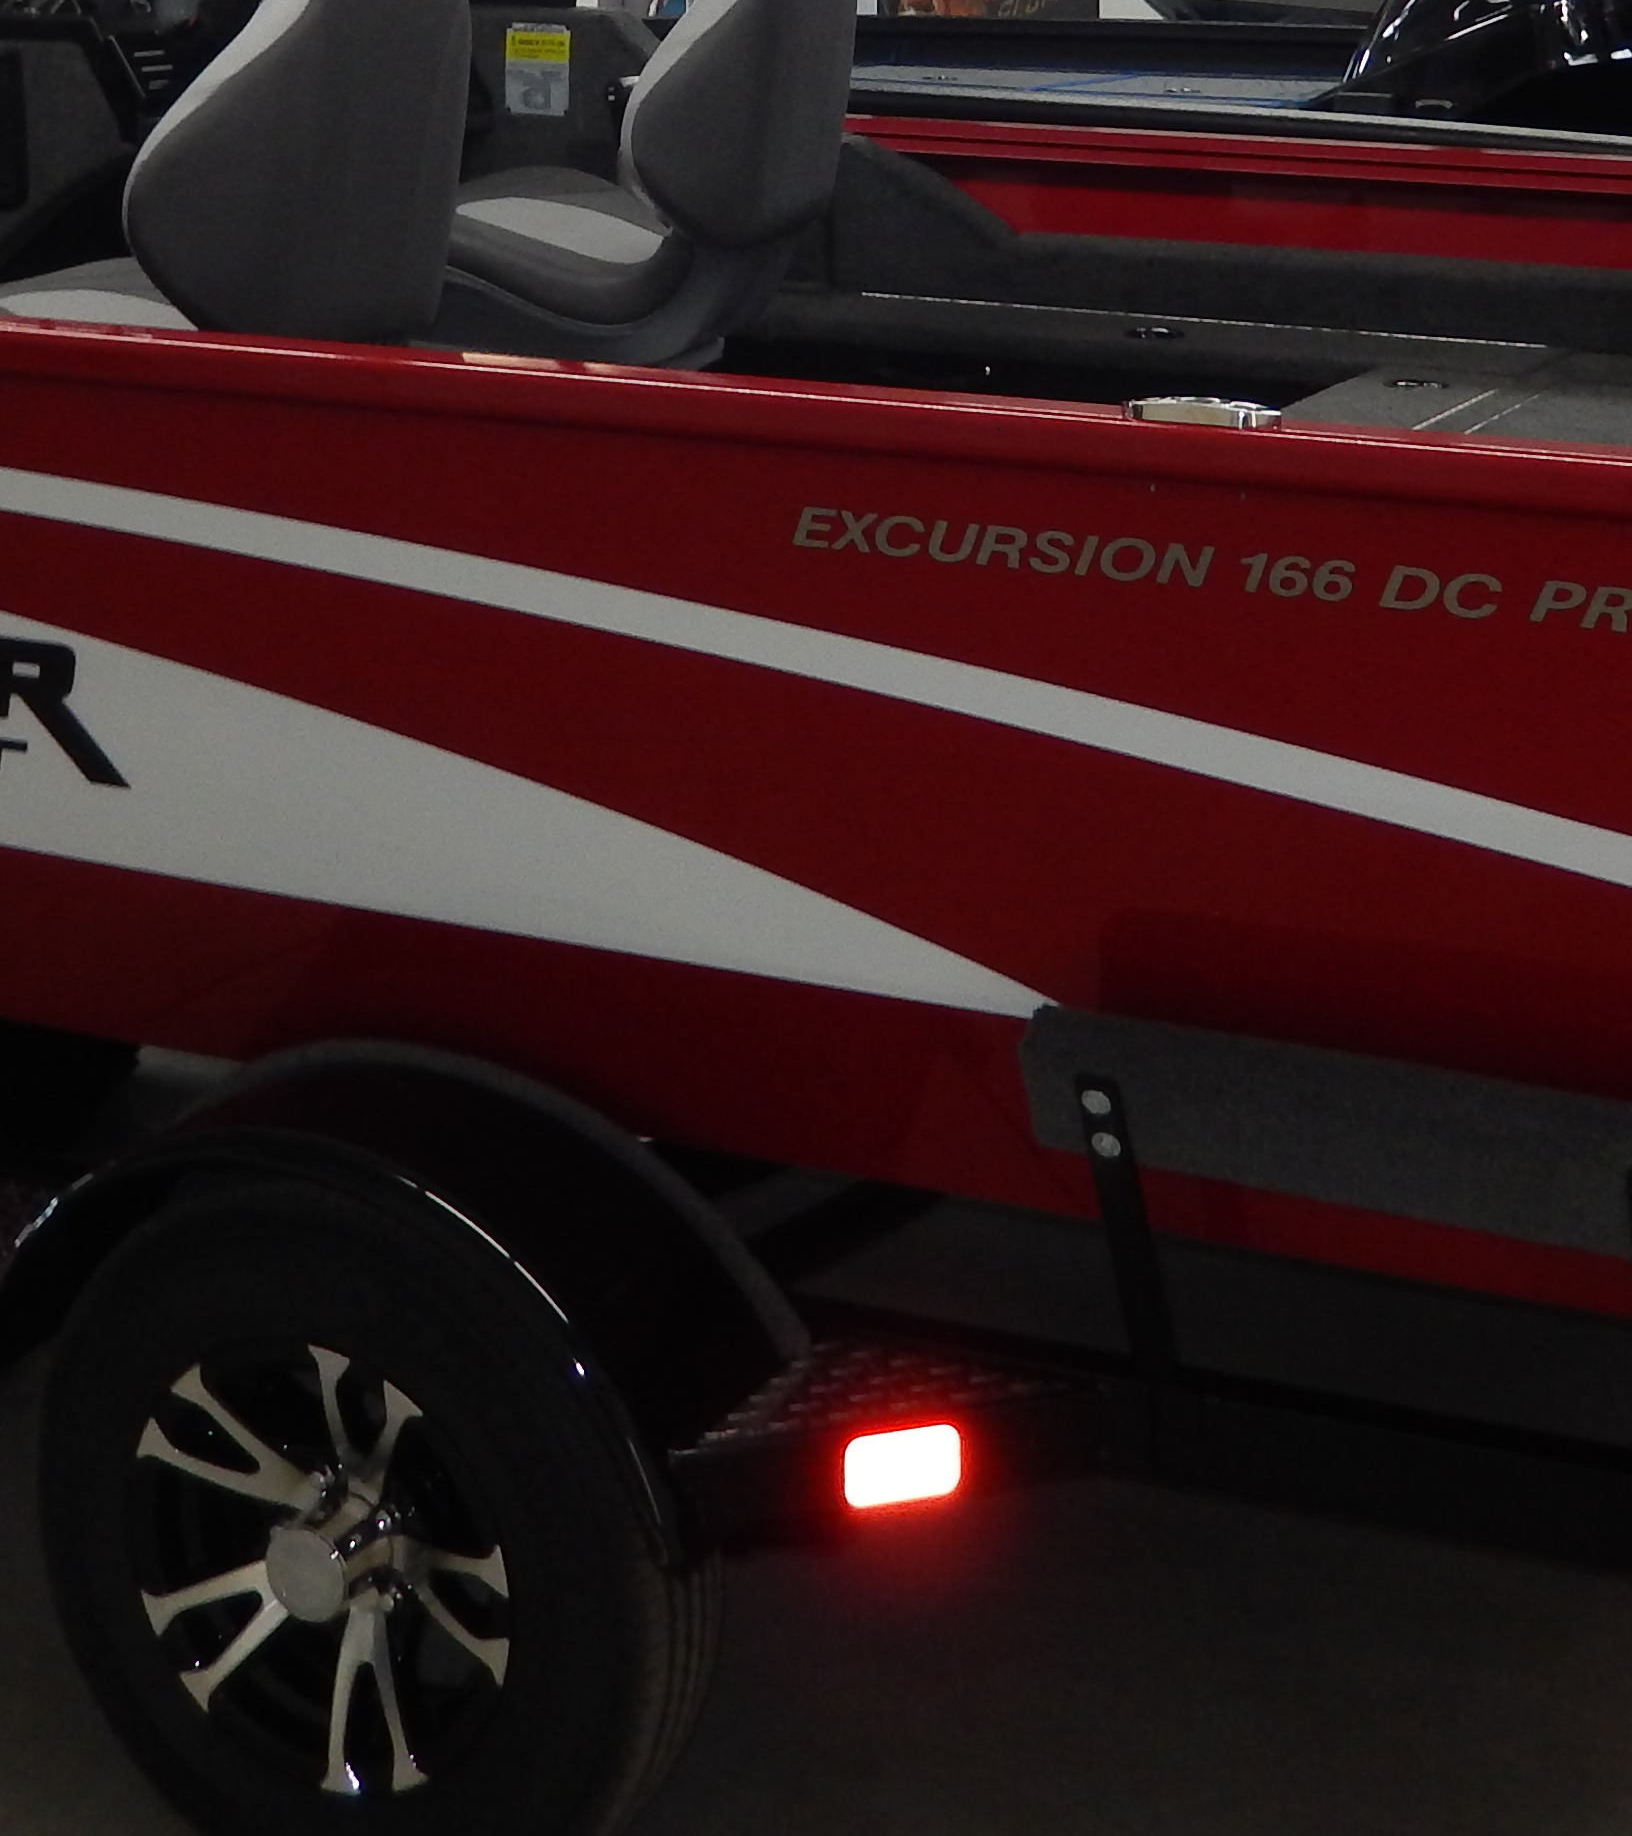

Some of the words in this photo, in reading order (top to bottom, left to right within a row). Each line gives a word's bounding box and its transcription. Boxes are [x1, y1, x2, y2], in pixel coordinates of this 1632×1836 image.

[792, 506, 1216, 588] EXCURSION
[1239, 552, 1357, 602] 166
[1378, 565, 1503, 621] DC
